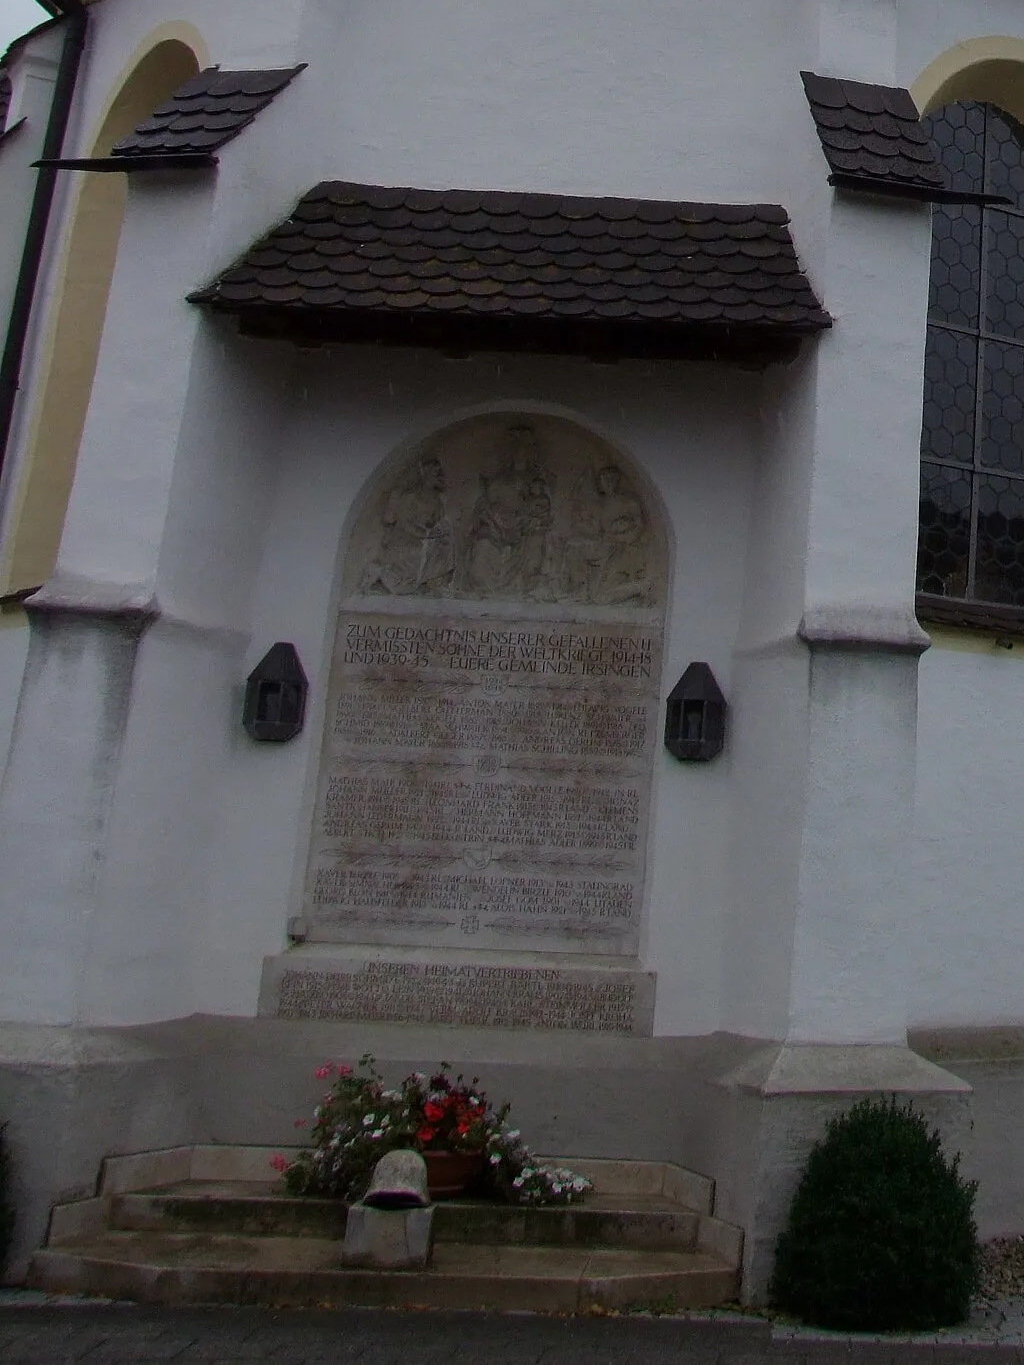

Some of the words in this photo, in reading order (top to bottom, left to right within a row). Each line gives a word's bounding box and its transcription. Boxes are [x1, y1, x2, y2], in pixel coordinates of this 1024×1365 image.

[347, 624, 381, 638] ZUM
[480, 631, 544, 645] UNSERER
[547, 633, 638, 651] GEFALLENEN
[346, 638, 434, 653] VERMISSTEN
[488, 644, 516, 658] DER
[519, 646, 606, 662] WELTKRIEGE
[611, 650, 652, 664] 1914-18
[344, 651, 375, 664] UND
[377, 653, 429, 667] 1939-45
[449, 656, 495, 670] EUERE
[498, 658, 576, 674] GEMEINDE
[581, 662, 652, 678] IRSINGEN
[363, 961, 420, 976] UNSEREN
[424, 964, 560, 981] HEIMATVERTRIEBENEN
